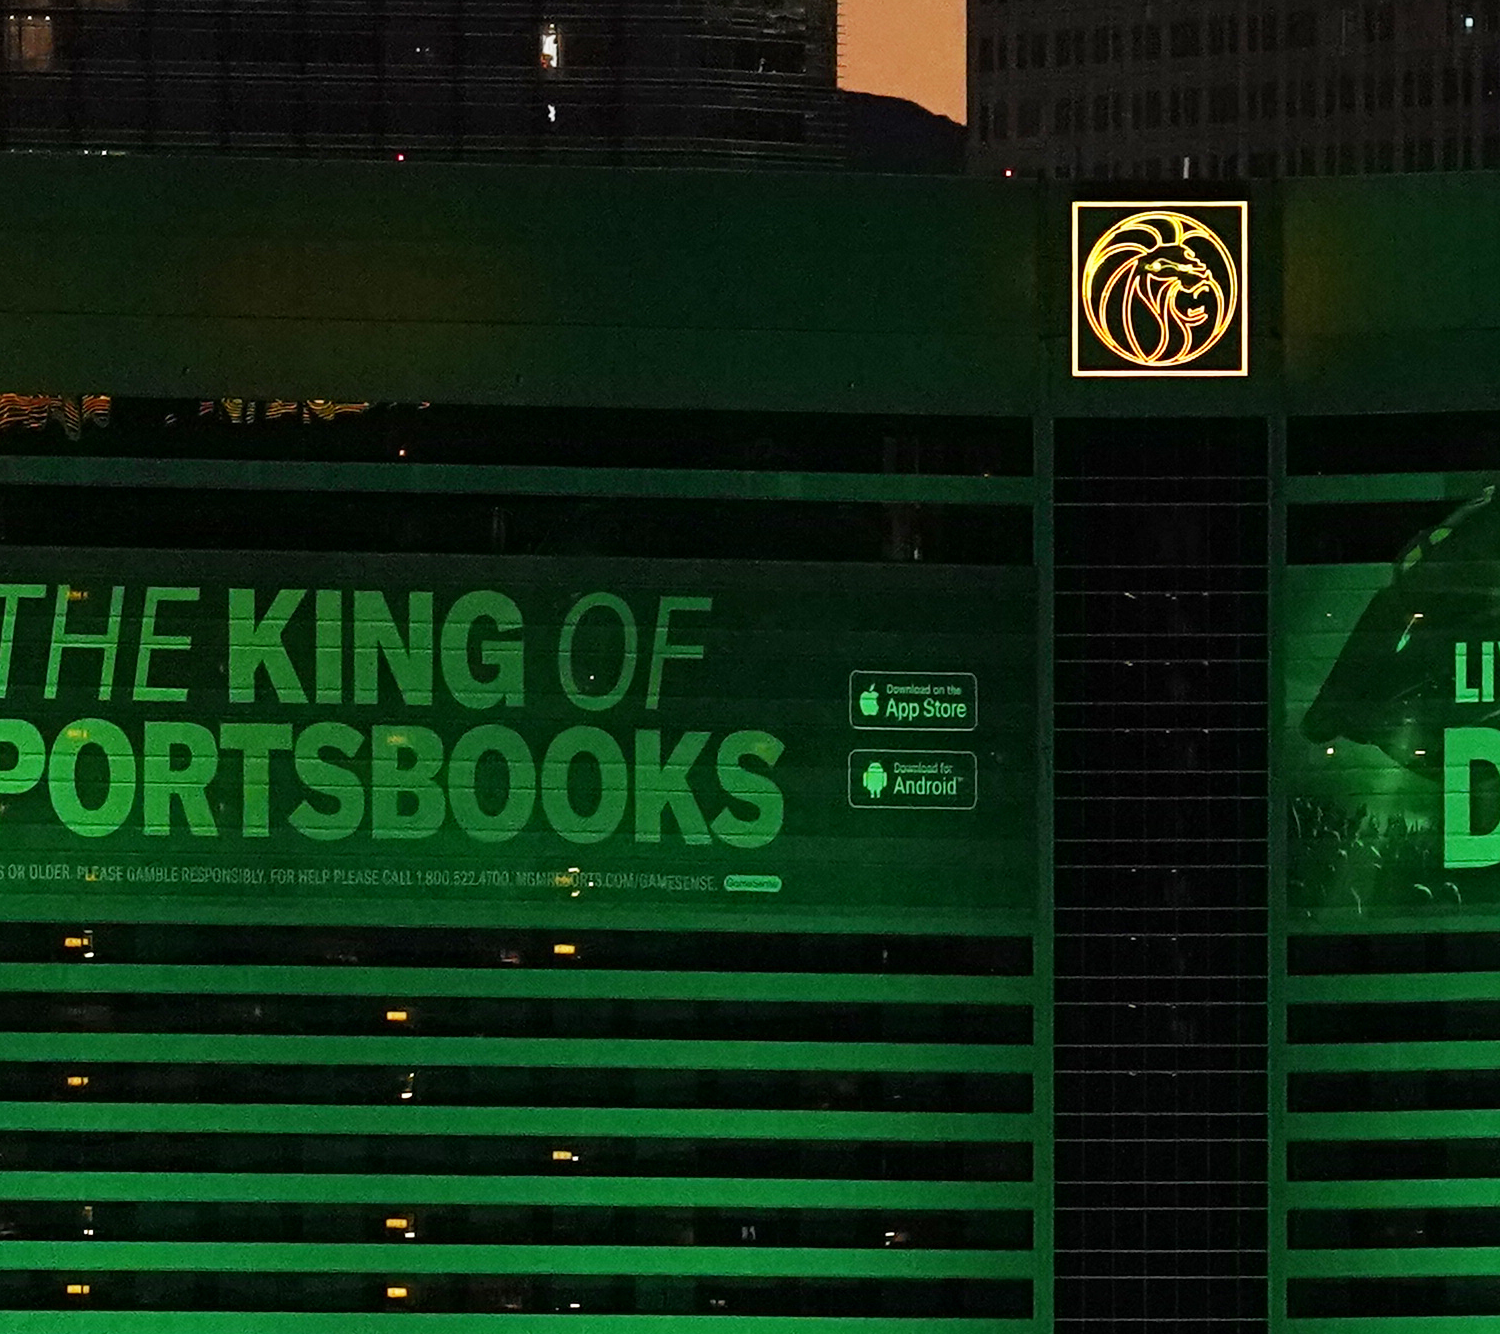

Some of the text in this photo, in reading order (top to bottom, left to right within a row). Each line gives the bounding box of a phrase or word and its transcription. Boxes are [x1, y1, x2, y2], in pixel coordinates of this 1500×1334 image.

[228, 589, 526, 709] KING
[558, 591, 713, 713] OF
[886, 684, 962, 696] Download on the
[886, 698, 967, 721] App Store
[894, 762, 954, 774] Download for
[8, 865, 25, 880] OR
[77, 866, 123, 882] PLEASE
[127, 866, 178, 882] GAMBLE
[271, 868, 294, 884] FOR
[299, 868, 329, 885] HELP
[334, 869, 380, 886] PLEASE
[382, 870, 413, 886] CALL
